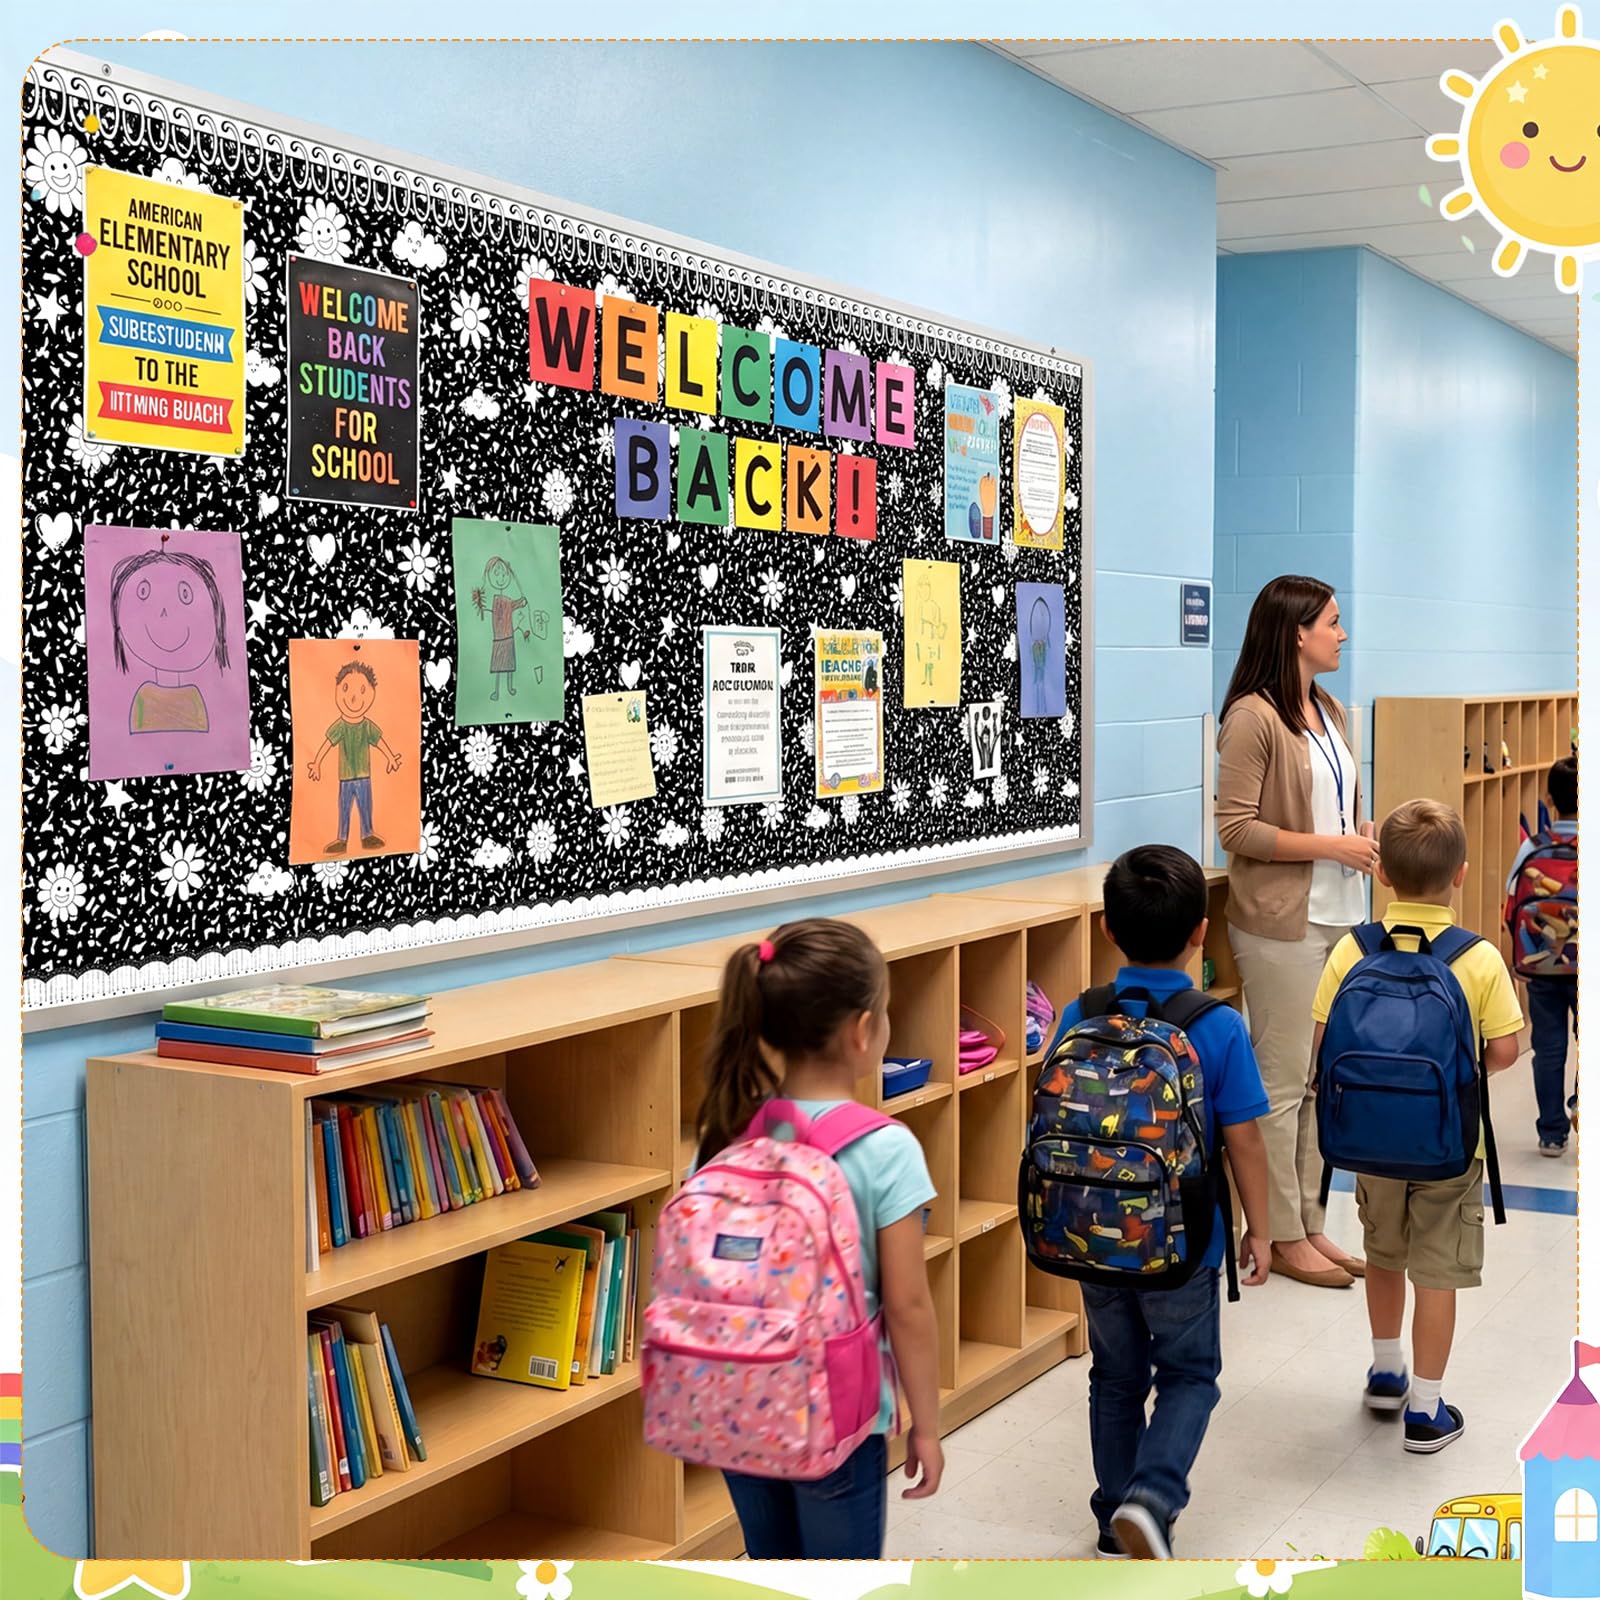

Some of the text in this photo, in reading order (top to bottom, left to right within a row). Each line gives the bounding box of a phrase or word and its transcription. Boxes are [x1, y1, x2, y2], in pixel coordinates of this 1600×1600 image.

[128, 198, 202, 233] AMERICAN
[99, 217, 231, 271] ELEMENTARY
[127, 258, 206, 299] SCHOOL
[299, 281, 409, 334] WELCOME
[327, 327, 386, 367] BACK
[535, 296, 906, 435] WELCOME
[134, 356, 199, 388] TO THE
[299, 361, 411, 410] STUDENTS
[173, 399, 224, 426] BUACH
[335, 407, 378, 444] FOR
[311, 443, 400, 485] SCHOOL
[628, 434, 860, 525] BACK!
